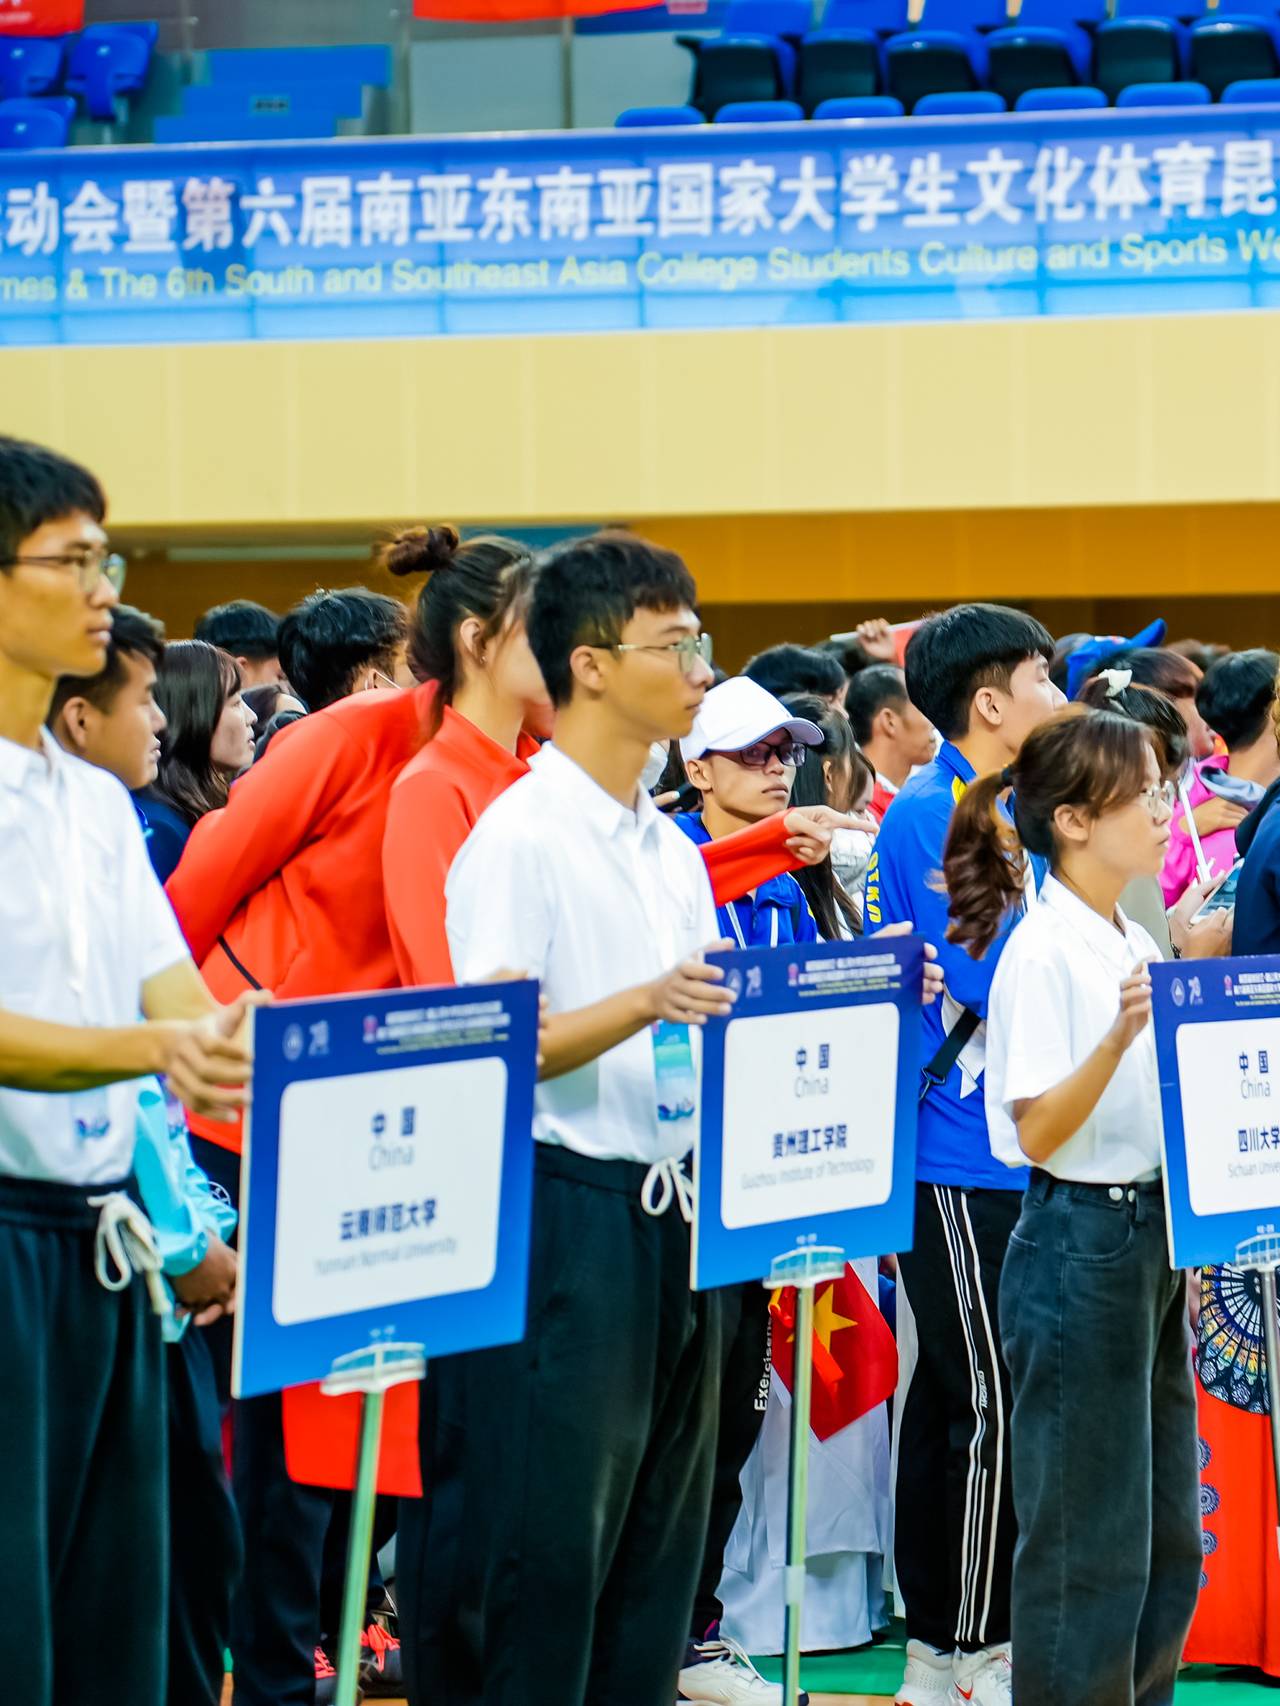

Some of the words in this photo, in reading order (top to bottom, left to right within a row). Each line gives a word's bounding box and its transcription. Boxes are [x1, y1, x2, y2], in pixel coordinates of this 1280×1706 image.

[67, 268, 89, 300] &
[99, 266, 157, 299] The
[166, 264, 215, 300] 6th
[224, 262, 313, 296] South
[324, 260, 381, 293] and
[397, 254, 549, 291] Southeast
[558, 253, 628, 288] Asia
[636, 250, 759, 292] College
[767, 243, 910, 282] Students
[918, 238, 1038, 275] Culture
[1047, 237, 1110, 270] and
[1119, 230, 1228, 271] Sports
[794, 1075, 829, 1099] China
[1240, 1077, 1271, 1100] China
[1238, 1126, 1280, 1153] 四川大学
[369, 1145, 415, 1172] China
